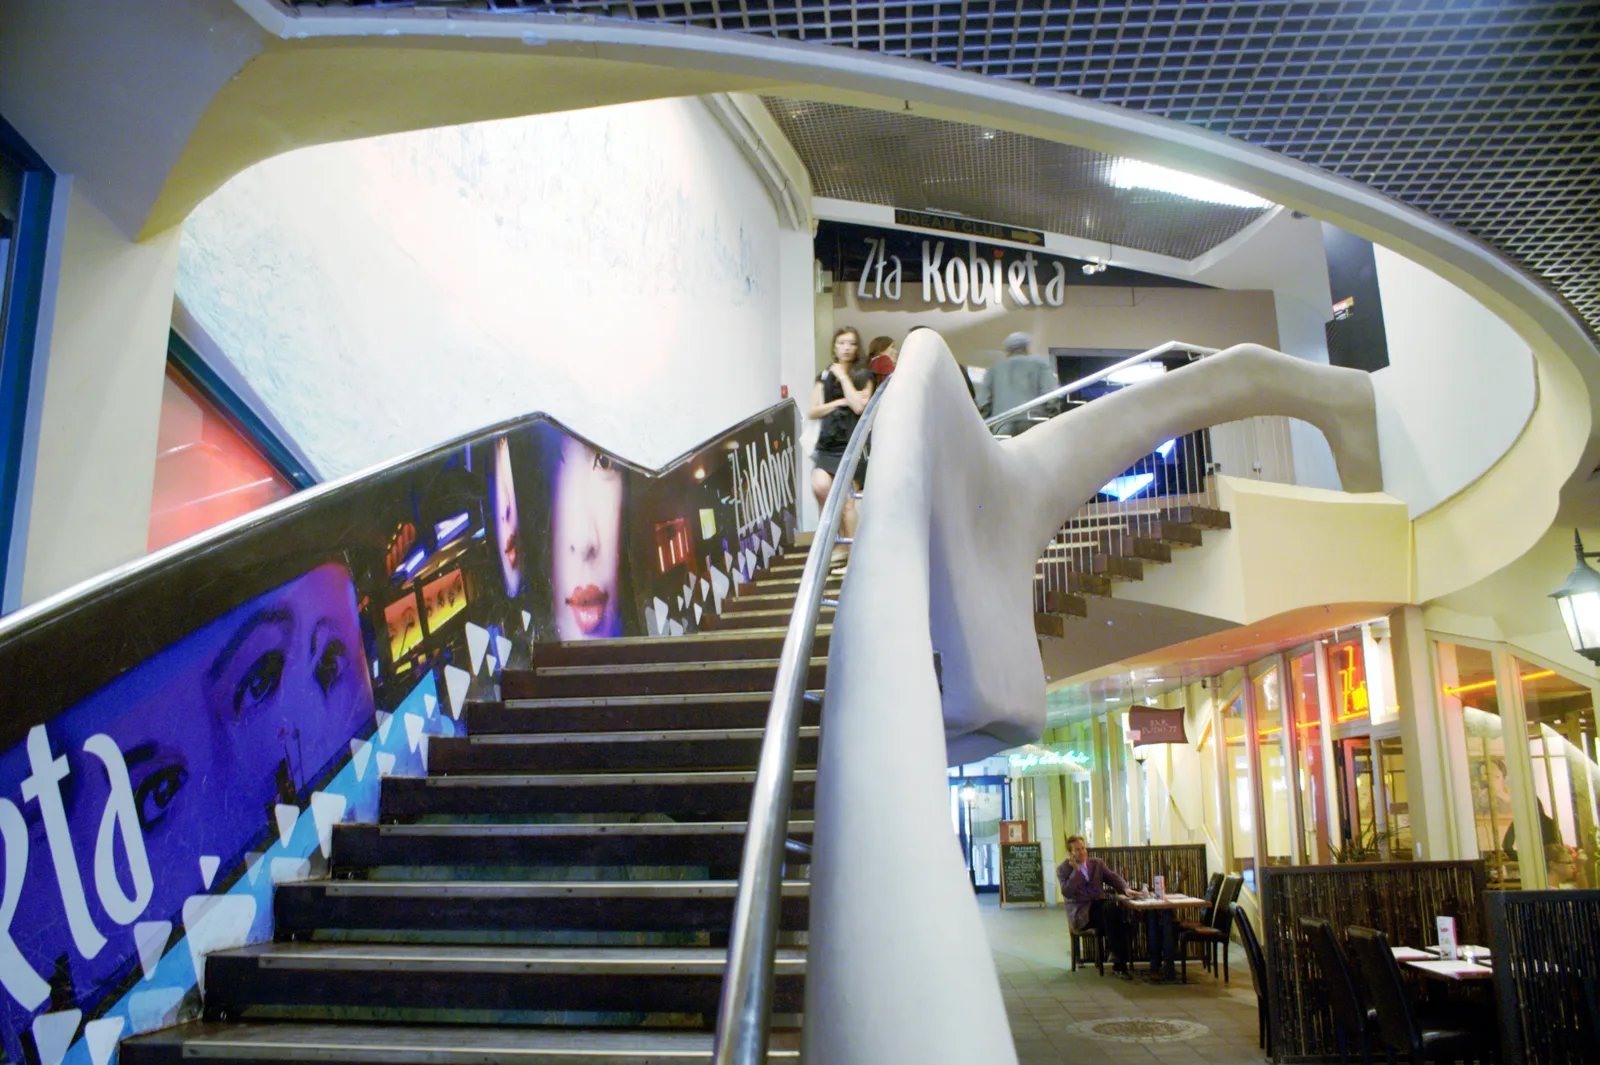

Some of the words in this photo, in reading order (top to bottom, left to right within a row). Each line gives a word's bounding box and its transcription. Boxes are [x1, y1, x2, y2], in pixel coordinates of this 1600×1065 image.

[897, 210, 956, 231] DREAM
[857, 237, 902, 300] Zła
[922, 240, 1065, 307] Kobieta
